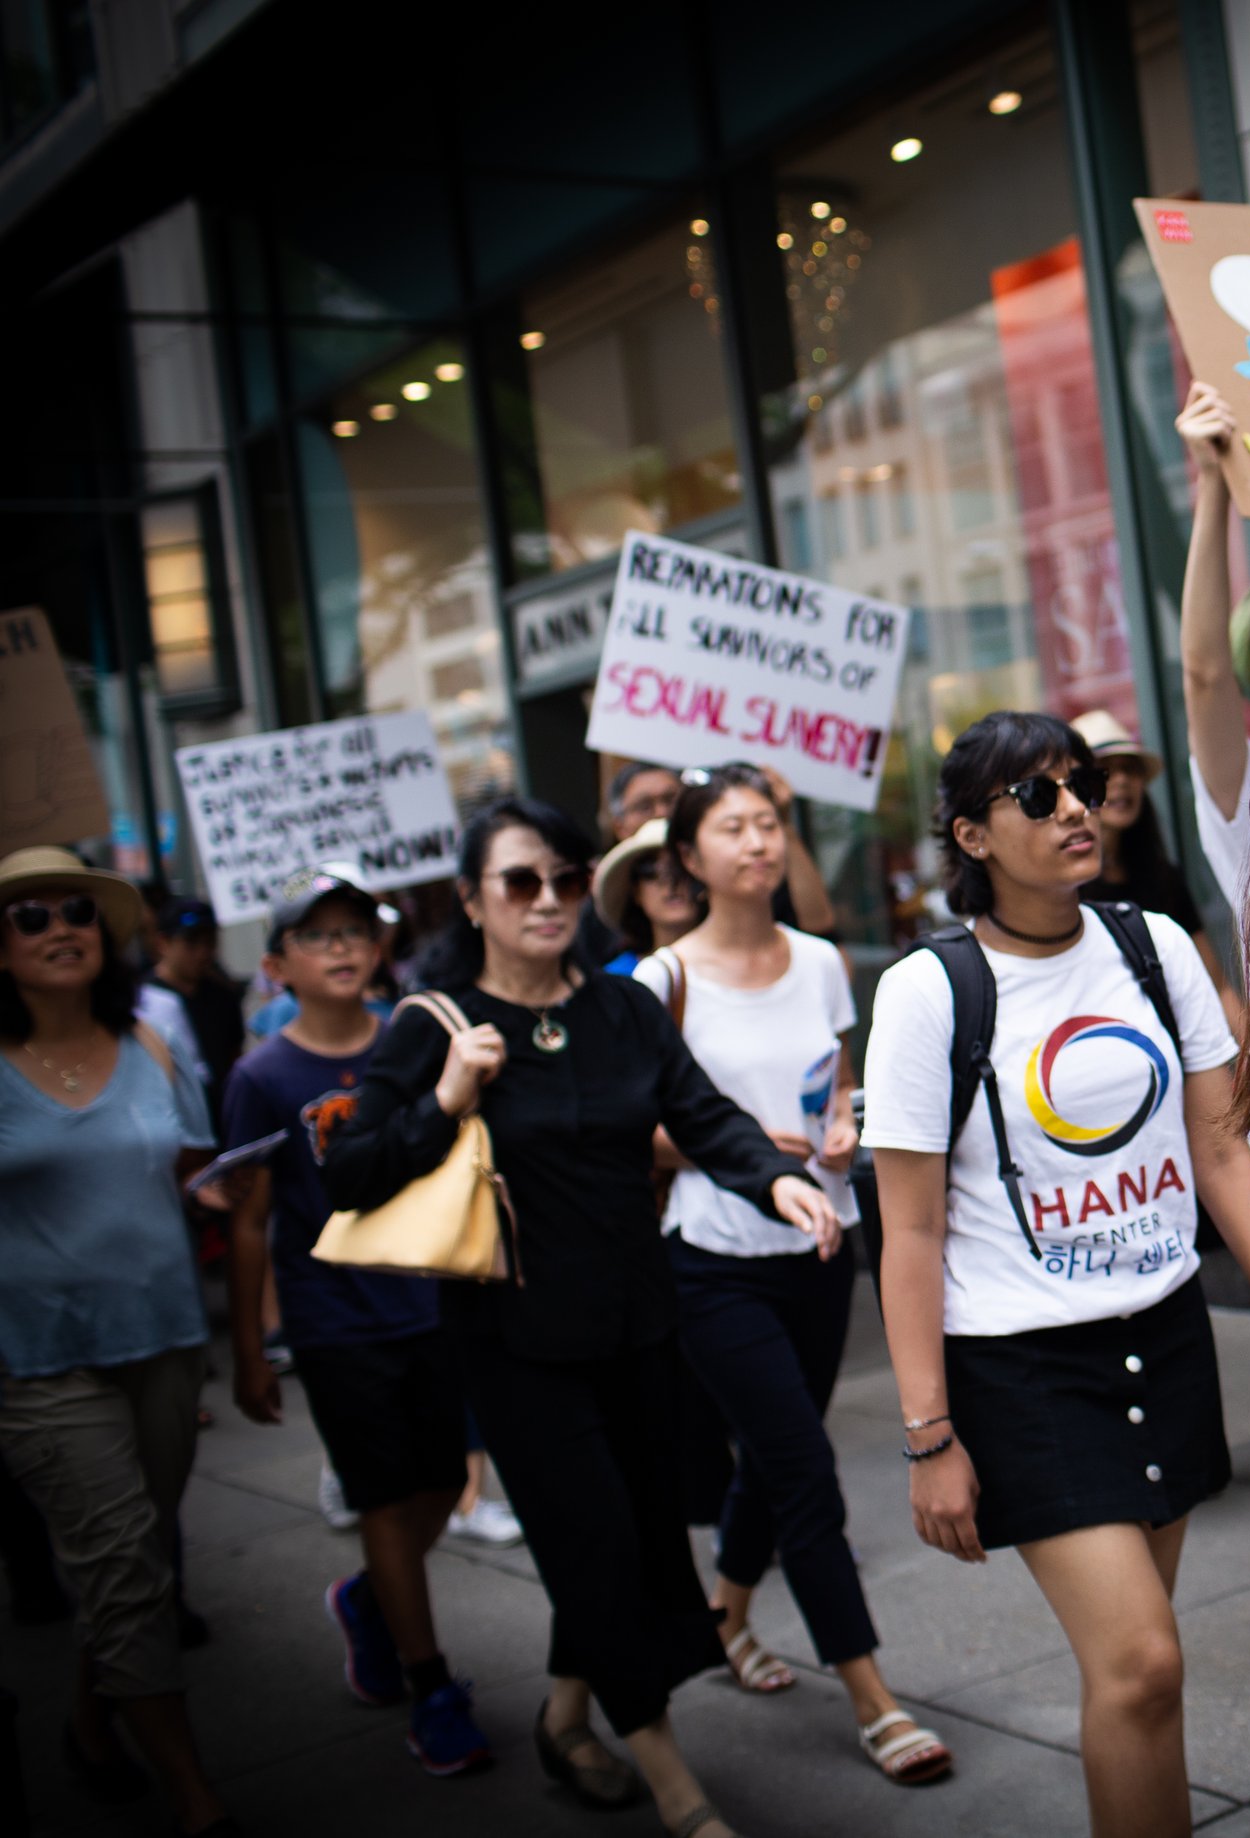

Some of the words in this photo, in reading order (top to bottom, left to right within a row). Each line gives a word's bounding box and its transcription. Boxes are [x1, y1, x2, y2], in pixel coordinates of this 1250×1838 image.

[520, 600, 593, 656] ANN
[844, 602, 896, 650] FOR
[687, 614, 833, 684] SURVIVORS
[838, 660, 879, 693] OF
[602, 661, 730, 737] SEXUAL
[739, 694, 883, 779] SLAVERY!
[358, 825, 457, 877] NOW!
[1031, 1157, 1186, 1232] HANA
[1073, 1212, 1162, 1246] CENTER
[1043, 1244, 1117, 1280] 하나
